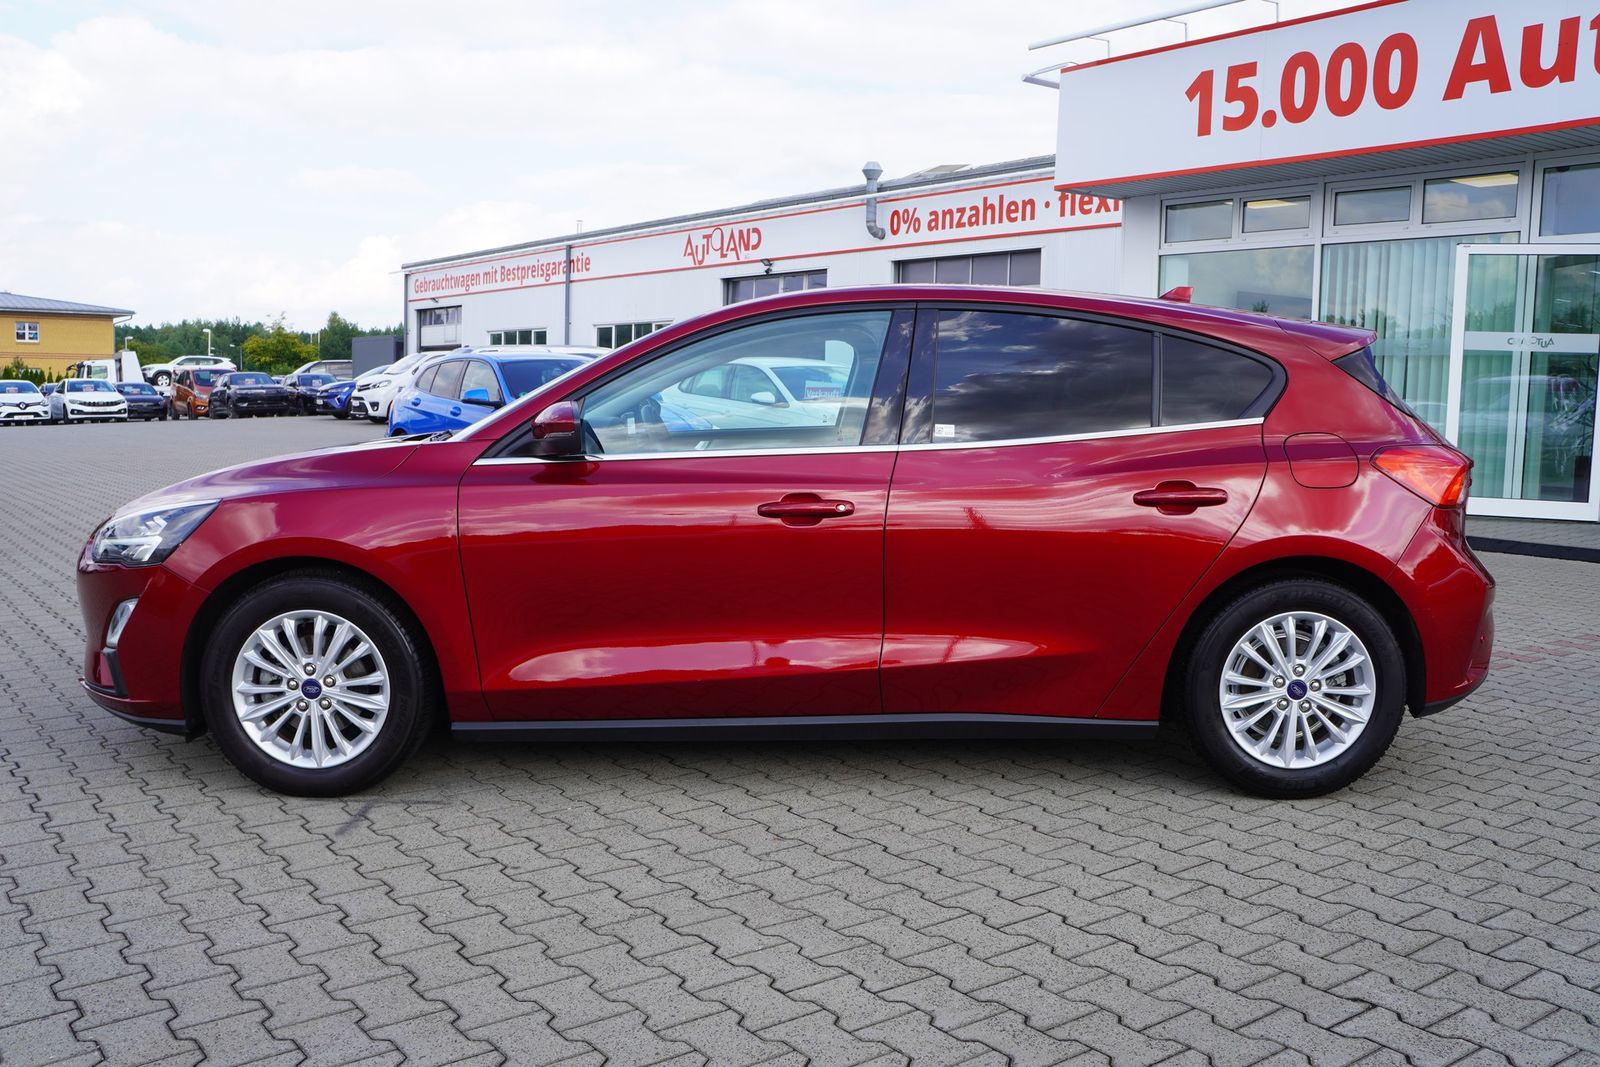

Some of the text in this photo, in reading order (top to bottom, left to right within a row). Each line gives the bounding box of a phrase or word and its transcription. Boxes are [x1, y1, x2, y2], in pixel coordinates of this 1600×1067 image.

[1185, 32, 1418, 137] 15.000
[889, 207, 922, 236] 0%
[927, 194, 1036, 232] anzahlen
[683, 227, 762, 266] AUTOLAND
[414, 251, 591, 294] Gebrauchtwagen mit Bestpreisgarantie
